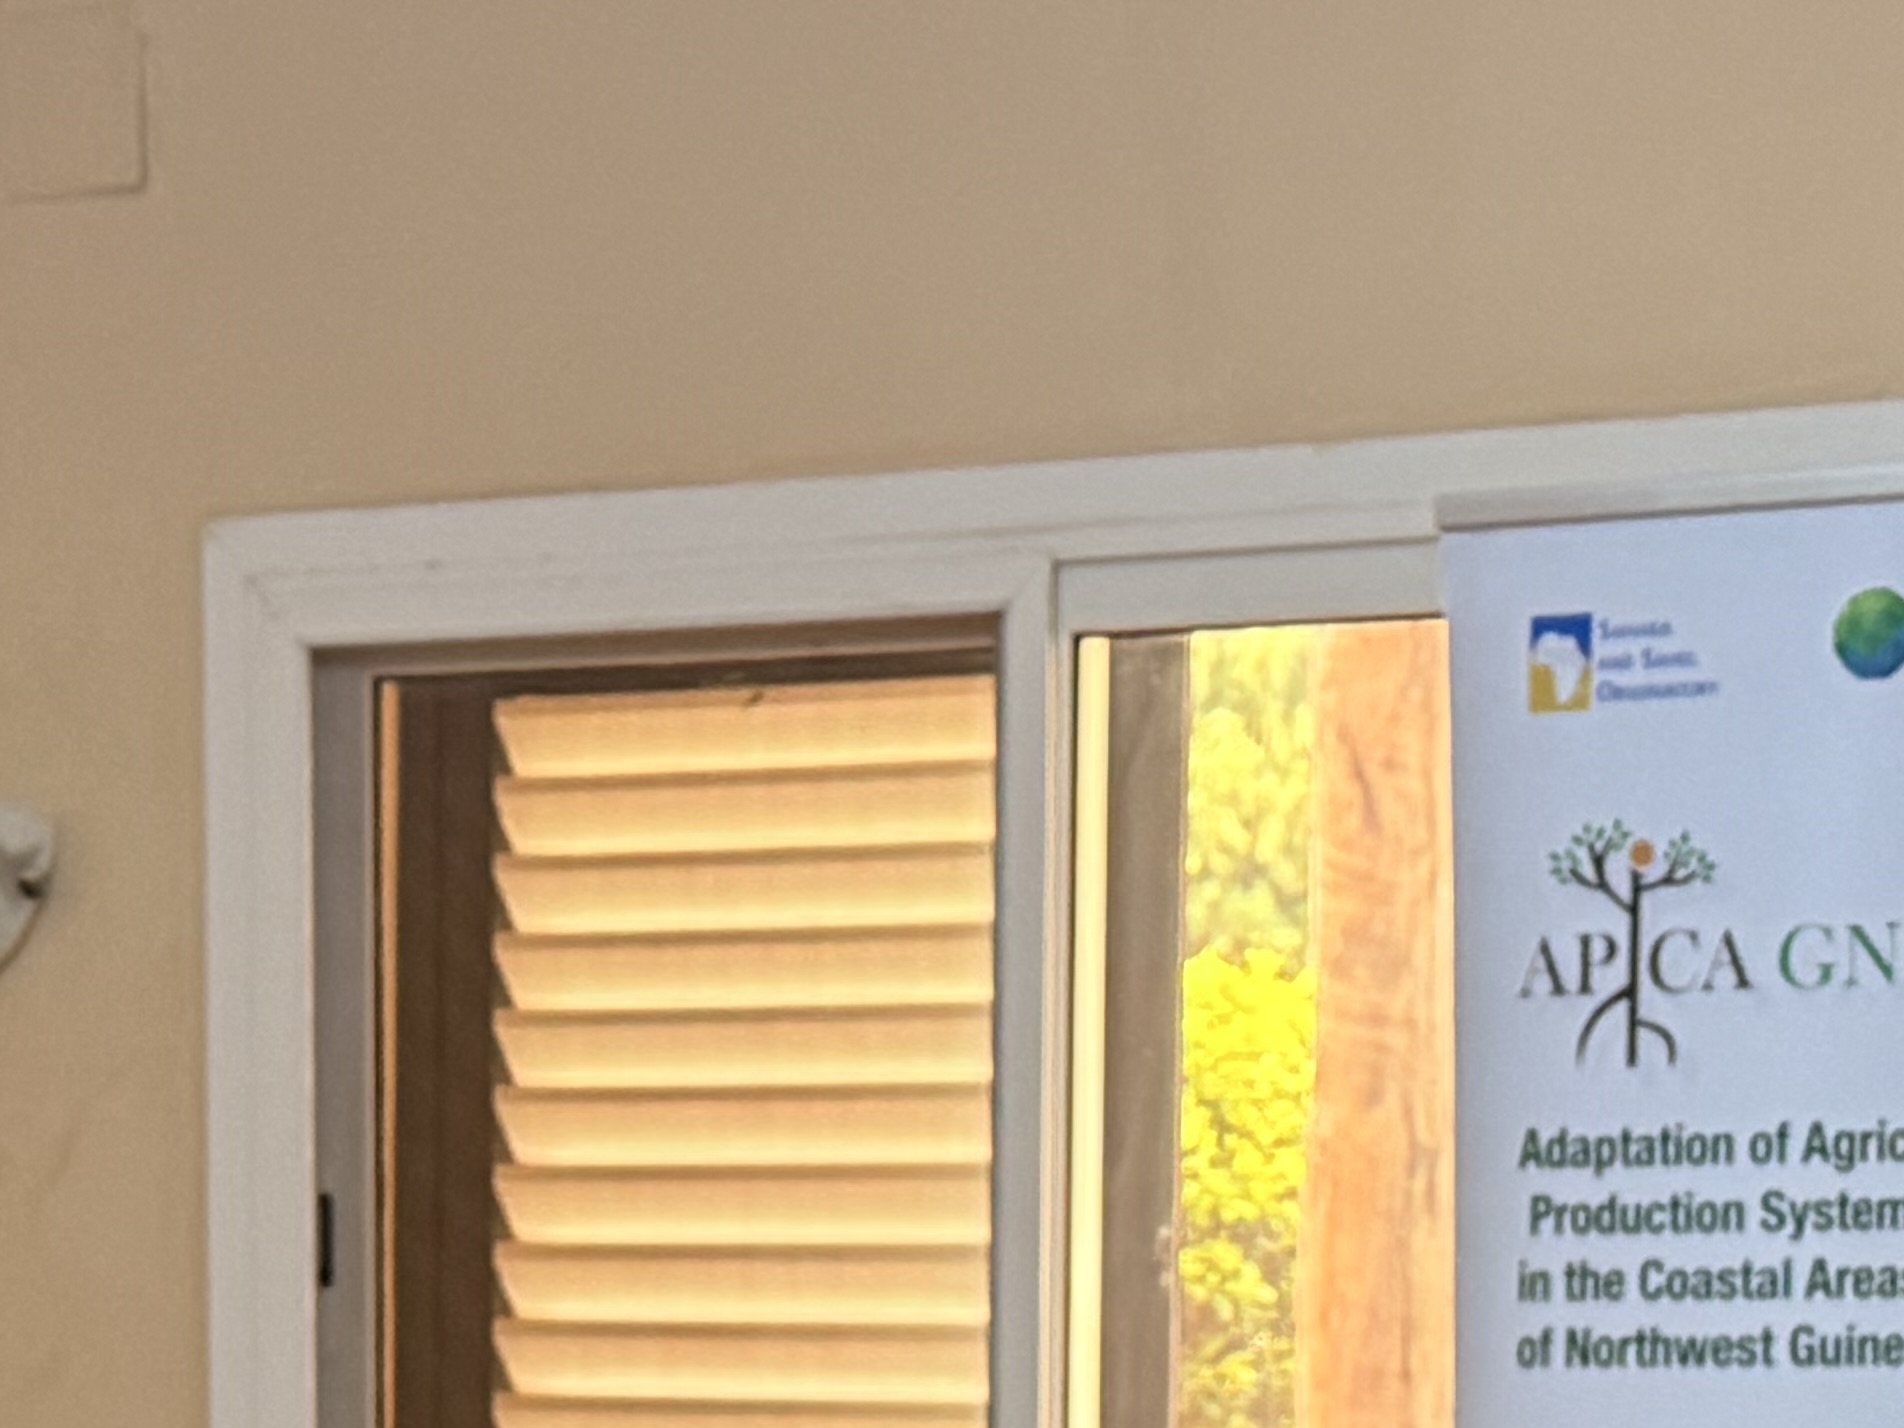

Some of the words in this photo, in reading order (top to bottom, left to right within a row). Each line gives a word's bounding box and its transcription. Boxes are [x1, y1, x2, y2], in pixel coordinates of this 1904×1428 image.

[1518, 1123, 1735, 1178] Adaptation
[1748, 1120, 1790, 1166] of
[1529, 1191, 1746, 1237] Production
[1517, 1260, 1552, 1303] in
[1563, 1260, 1626, 1303] the
[1638, 1257, 1793, 1303] Coastal
[1516, 1326, 1554, 1370] of
[1564, 1326, 1775, 1369] Northwest
